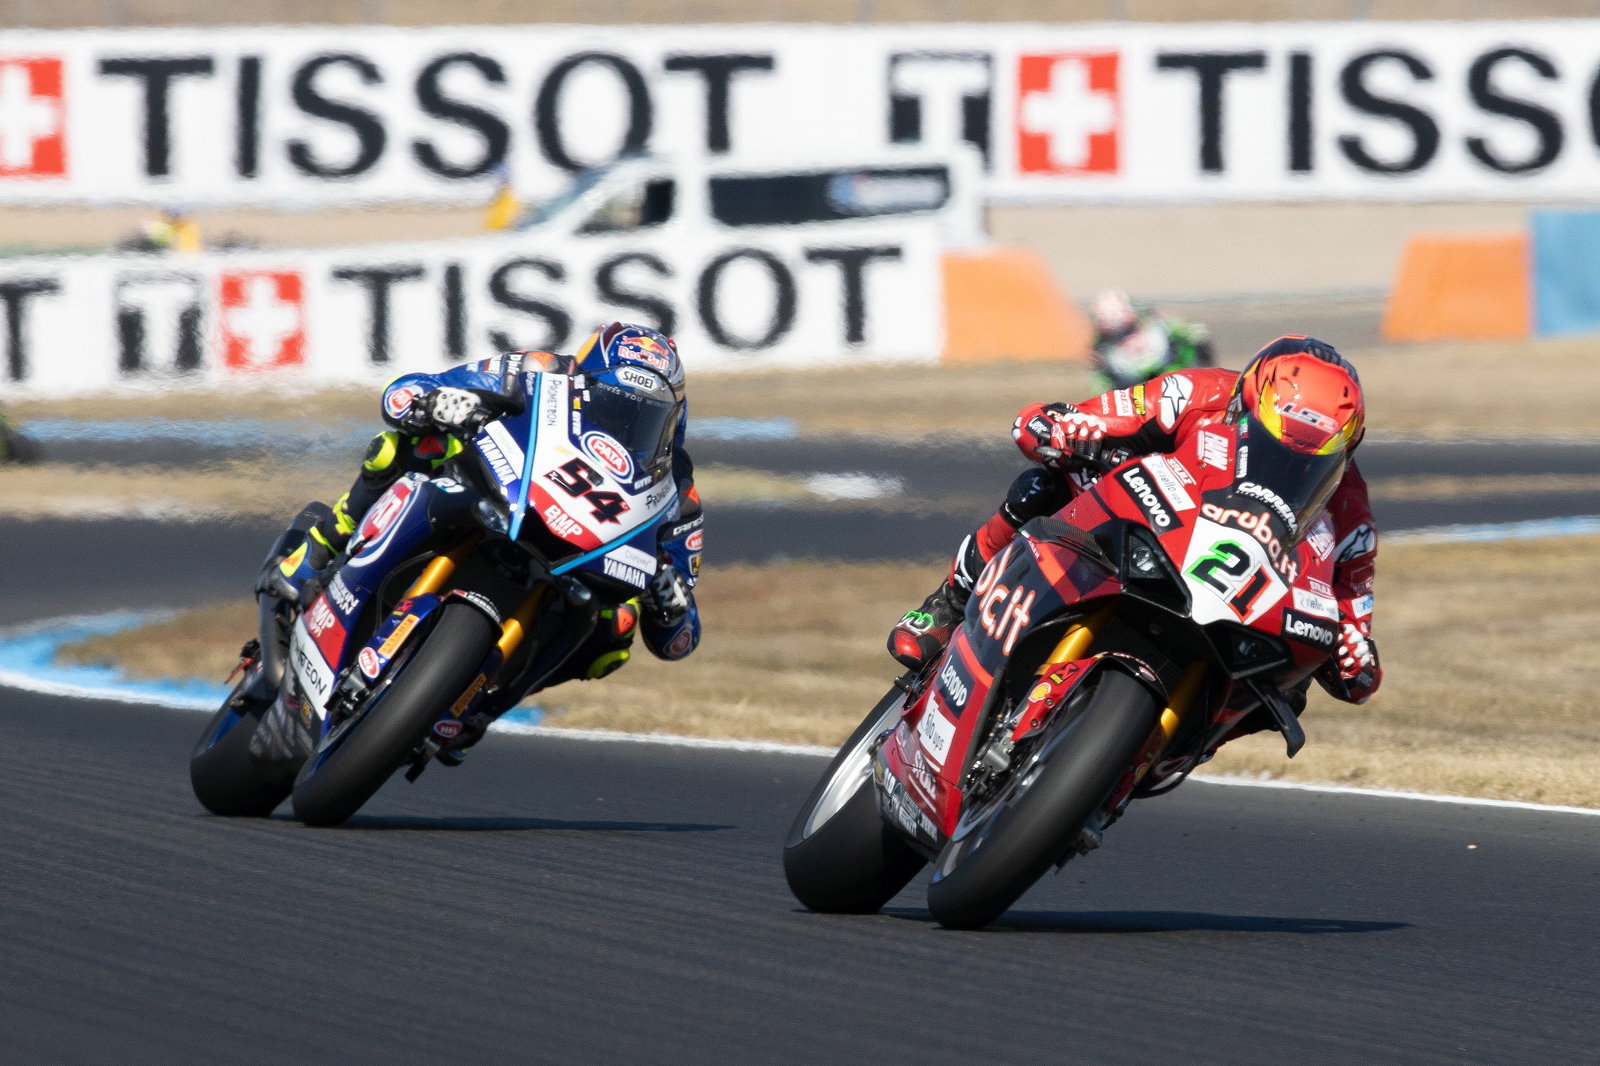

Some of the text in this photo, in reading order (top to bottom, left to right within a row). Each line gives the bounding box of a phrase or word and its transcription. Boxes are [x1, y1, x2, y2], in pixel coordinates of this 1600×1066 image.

[98, 51, 774, 177] TISSOT
[1155, 47, 1600, 175] TISS
[332, 247, 902, 363] TISSOT
[547, 379, 562, 426] PROMETEON
[622, 370, 654, 389] SHOEI
[476, 435, 519, 487] YAMAHA
[593, 439, 624, 470] PATA
[542, 457, 631, 525] 54
[1122, 467, 1171, 527] Lenovo
[543, 504, 584, 536] BMP
[603, 557, 647, 590] YAMAHA
[1182, 539, 1271, 622] 21
[1285, 613, 1334, 646] Lenovo
[940, 654, 968, 707] Lenovo
